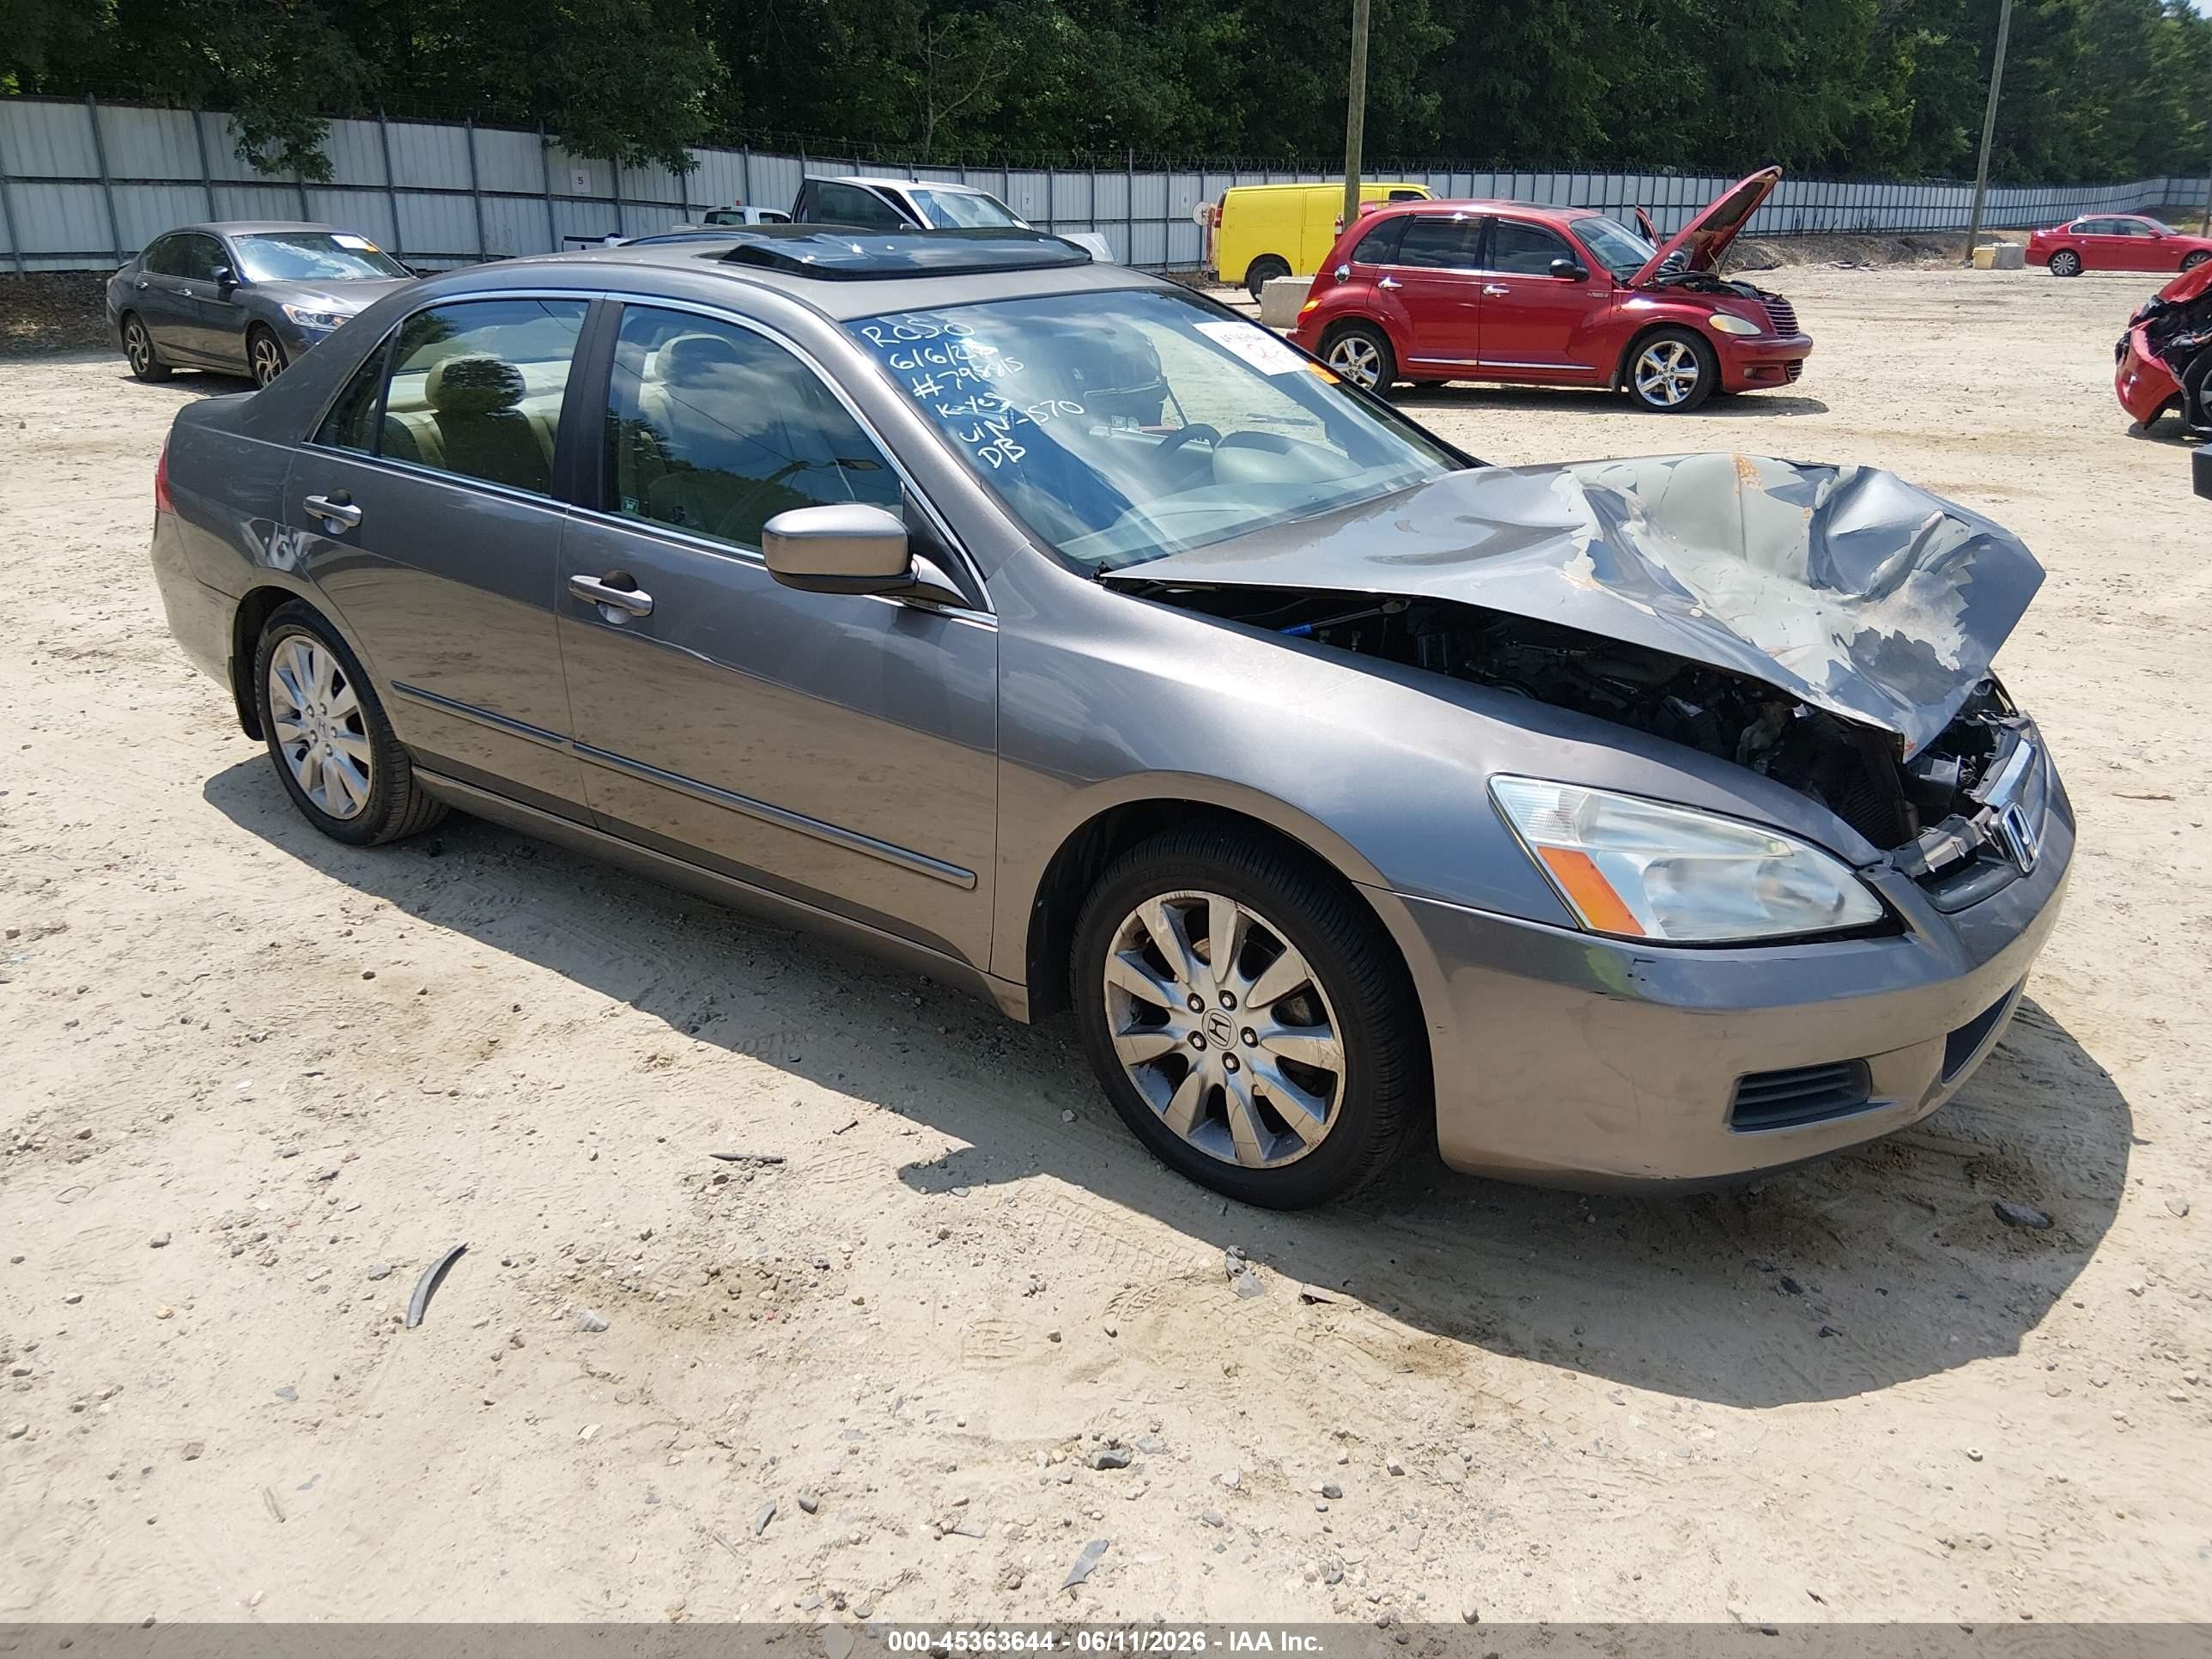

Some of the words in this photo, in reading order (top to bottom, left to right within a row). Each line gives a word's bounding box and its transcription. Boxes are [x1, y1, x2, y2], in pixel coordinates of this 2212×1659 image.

[576, 176, 584, 185] 5
[861, 319, 975, 348] RCSO
[977, 438, 1026, 469] DB
